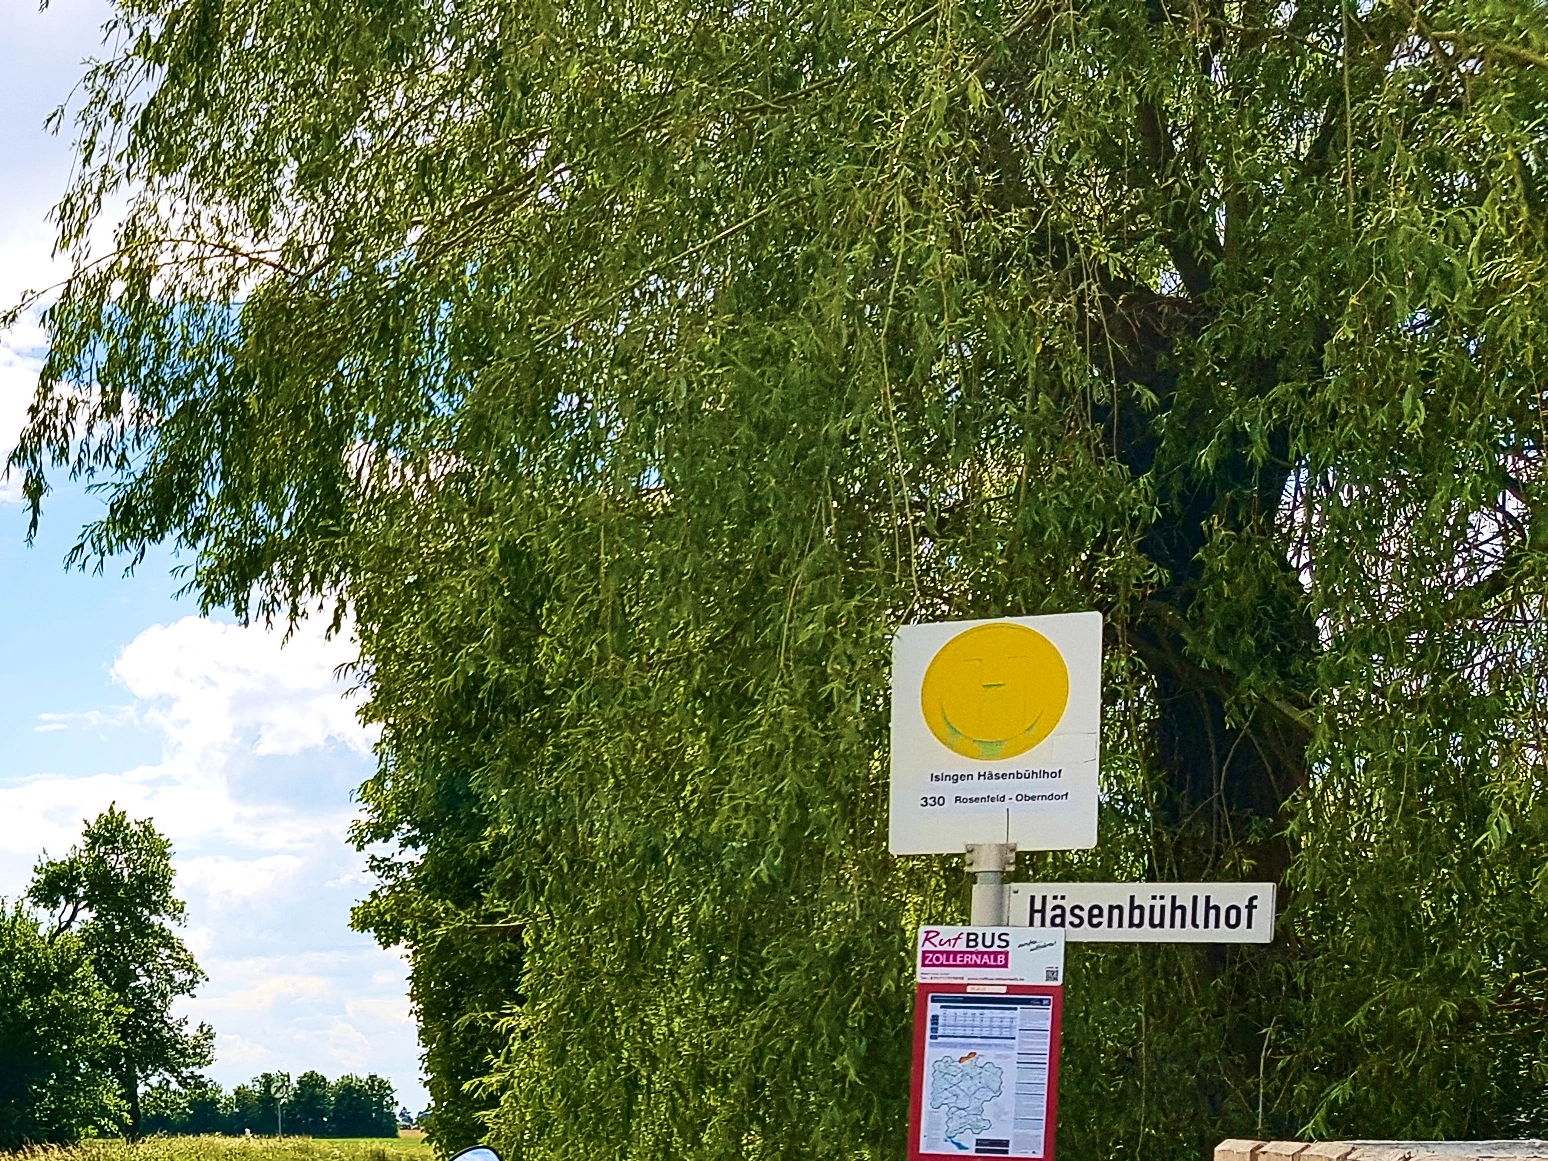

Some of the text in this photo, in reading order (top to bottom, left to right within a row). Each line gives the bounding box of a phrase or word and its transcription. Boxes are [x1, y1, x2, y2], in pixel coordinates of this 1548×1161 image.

[930, 768, 1063, 784] Isingen Häsenbühlhof
[920, 795, 946, 807] 330
[954, 794, 1006, 804] Rosenfeld
[1015, 791, 1069, 803] Oberndorf
[1028, 894, 1259, 930] Häsenbühlhof
[924, 952, 1006, 966] ZOLLERNALB
